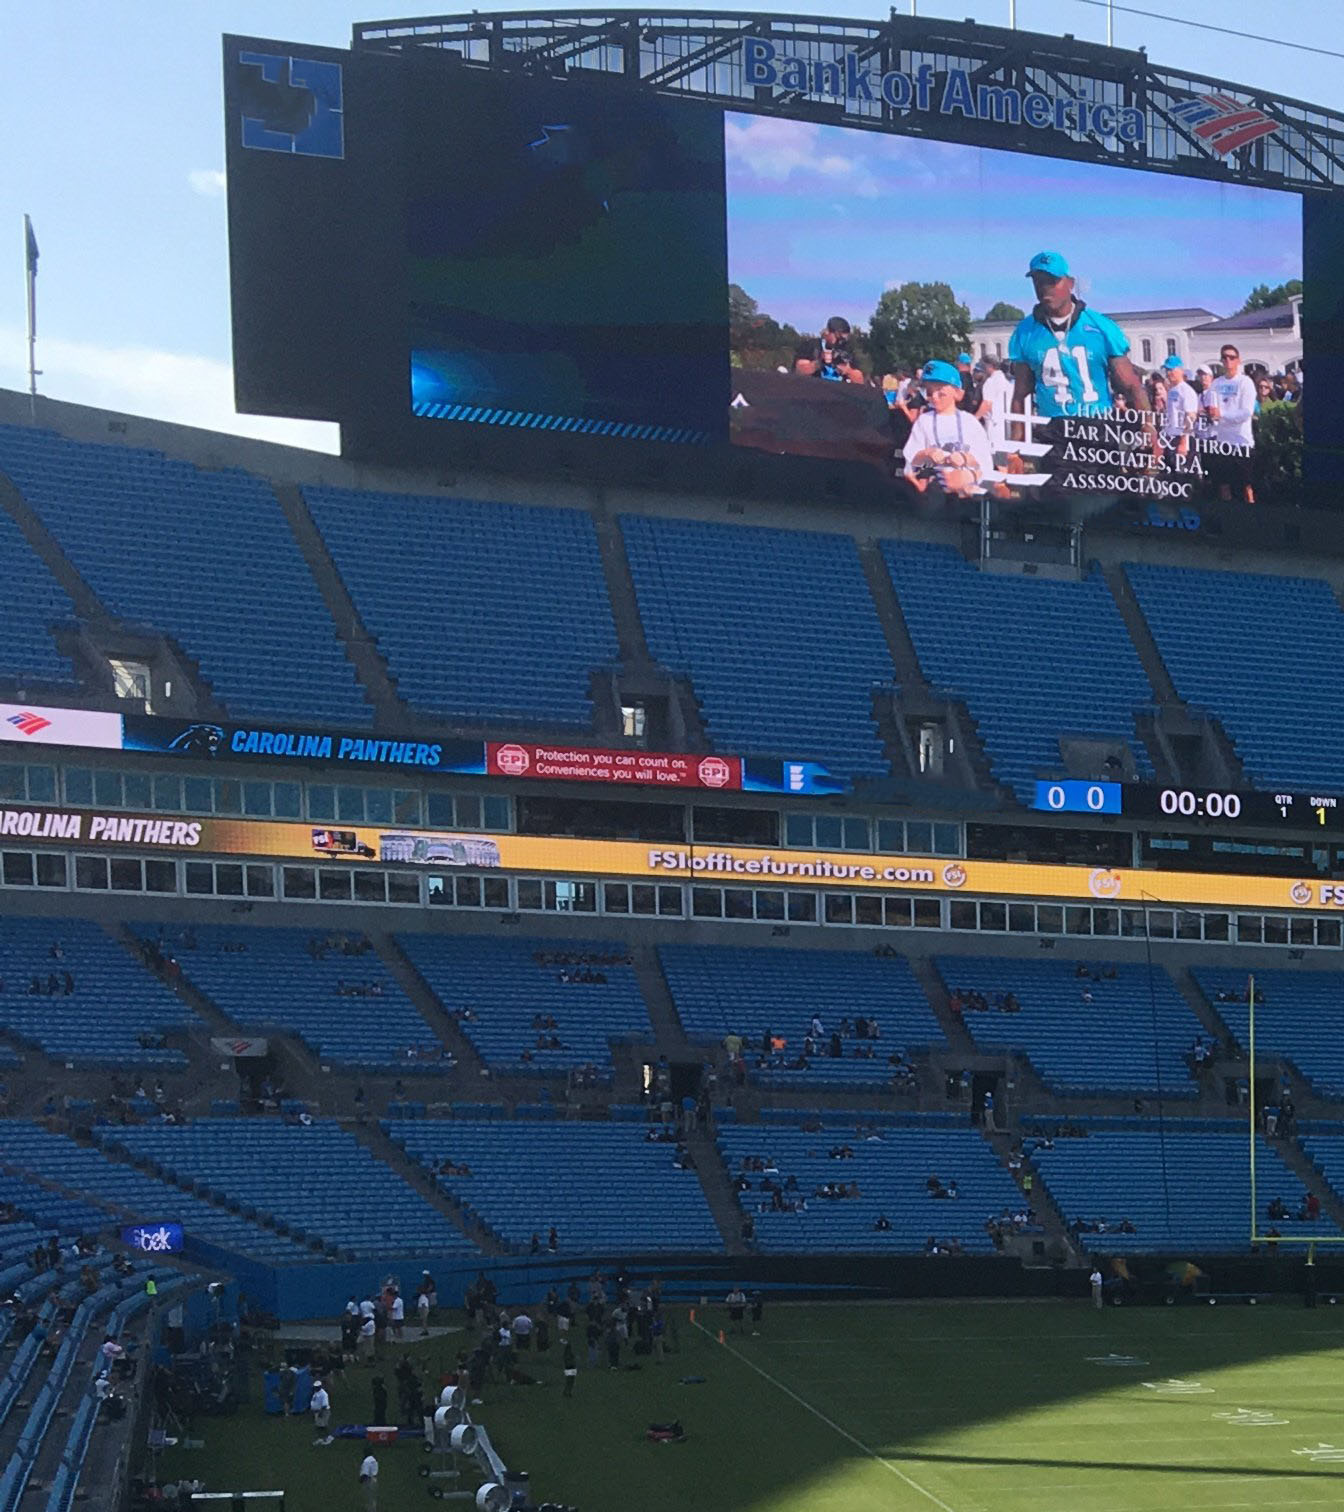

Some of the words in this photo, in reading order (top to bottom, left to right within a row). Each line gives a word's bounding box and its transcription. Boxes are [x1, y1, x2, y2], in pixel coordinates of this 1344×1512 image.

[741, 35, 876, 104] Bank
[881, 63, 935, 111] of
[940, 68, 1146, 144] America
[1042, 345, 1099, 402] 41
[1063, 419, 1100, 442] EAR
[1104, 424, 1153, 449] NOSE
[1157, 430, 1176, 450] &
[1179, 433, 1256, 458] THROAT
[1063, 441, 1172, 474] ASSOCIATES,
[1175, 454, 1209, 476] P.A.
[231, 730, 333, 759] CAROLINA
[338, 740, 443, 767] PANTHERS
[499, 753, 527, 766] CPI
[535, 748, 592, 764] Protection
[593, 752, 613, 766] you
[615, 755, 637, 766] can
[638, 754, 669, 768] count
[671, 758, 688, 769] on.
[535, 762, 610, 778] Conveniences
[611, 765, 633, 780] you
[635, 766, 654, 780] will
[700, 766, 728, 779] CPI
[1048, 786, 1066, 809] 0
[1086, 786, 1105, 810] 0
[1160, 789, 1242, 819] 00:00
[1274, 795, 1293, 805] QTR
[1310, 796, 1337, 808] DOWN
[1279, 806, 1287, 818] 1
[1315, 808, 1326, 825] 1
[0, 810, 82, 839] ROLINA
[89, 816, 203, 847] PANTHERS
[648, 850, 935, 884] FSIofficefurniture.com
